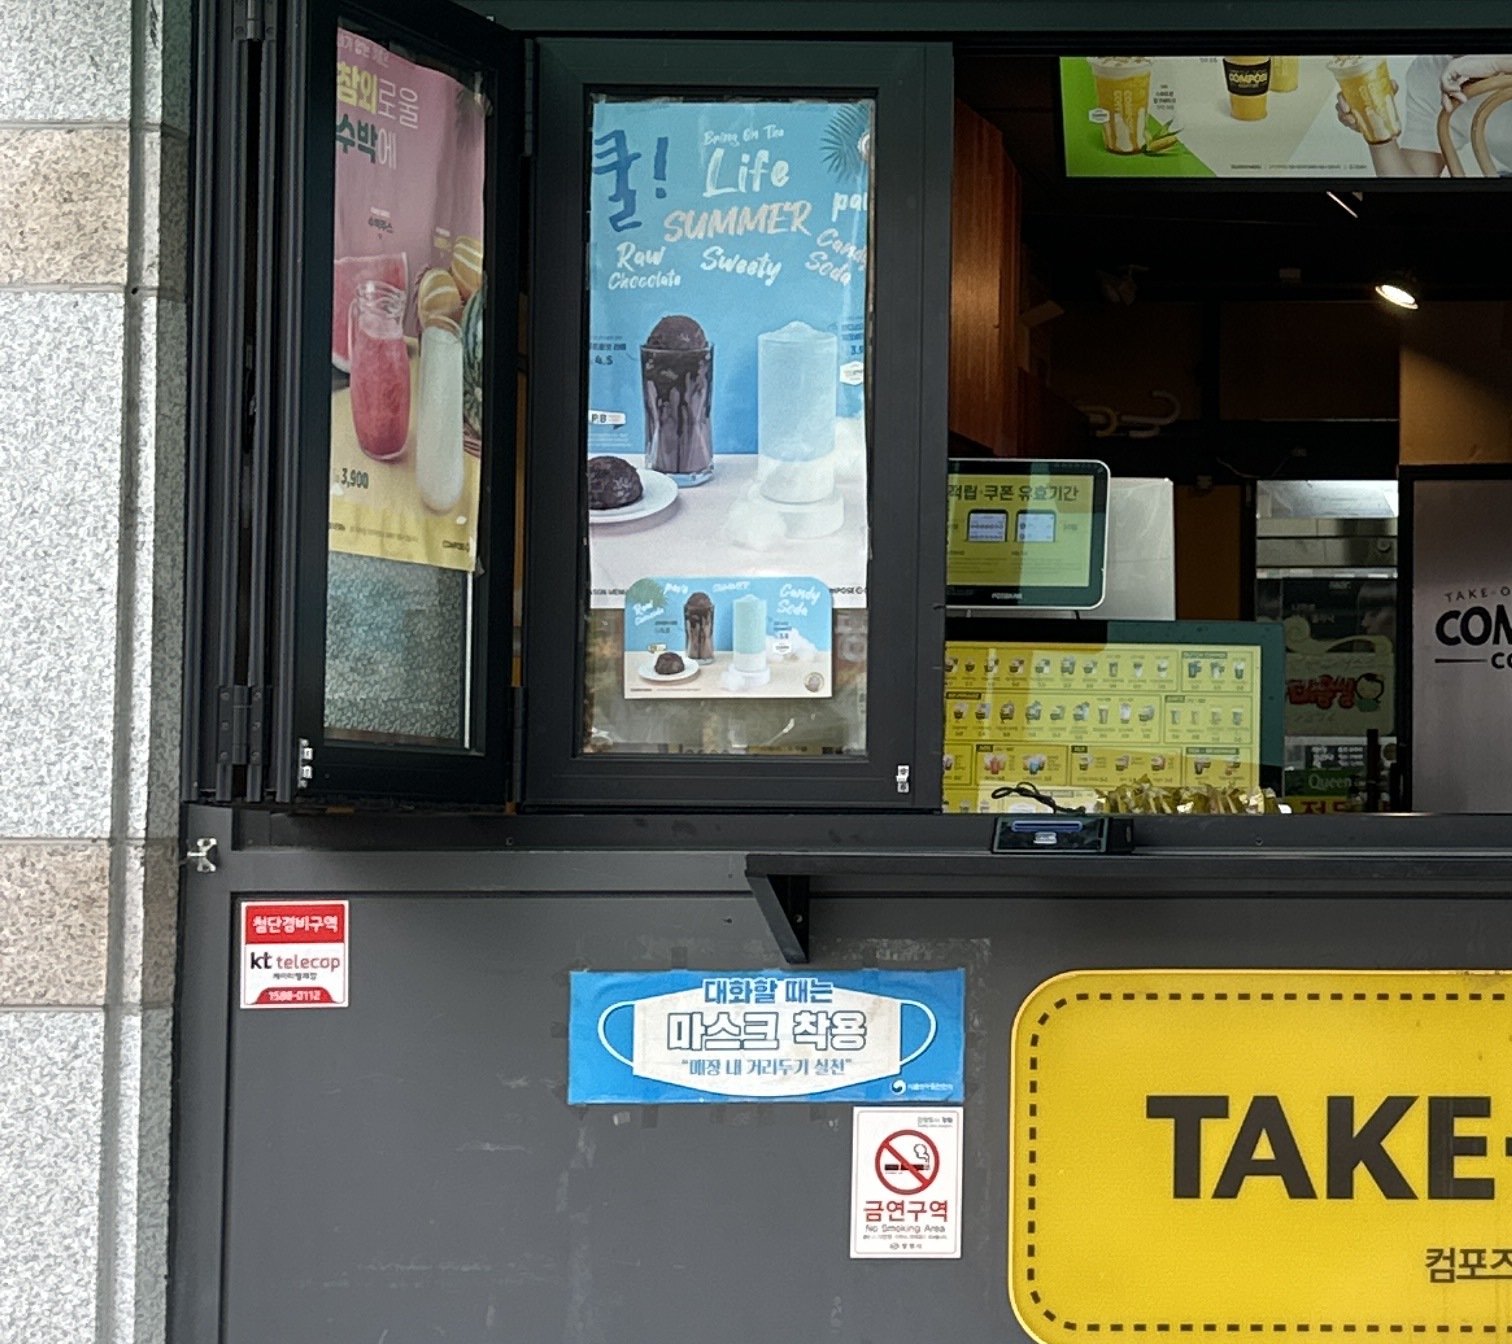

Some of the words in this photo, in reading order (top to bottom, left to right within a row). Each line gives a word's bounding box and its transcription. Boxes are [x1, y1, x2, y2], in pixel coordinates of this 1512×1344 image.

[702, 147, 790, 198] Life
[662, 199, 812, 244] SUMMER
[616, 240, 667, 273] Raw
[699, 245, 783, 288] Sweety
[250, 951, 273, 970] kt
[276, 952, 341, 973] telecop
[703, 977, 779, 1005] 대화할
[784, 977, 835, 1004] 때는
[666, 1010, 780, 1052] 마스크
[791, 1009, 867, 1051] 착용
[748, 1058, 810, 1076] 거리두기
[863, 1199, 949, 1223] 금연구역
